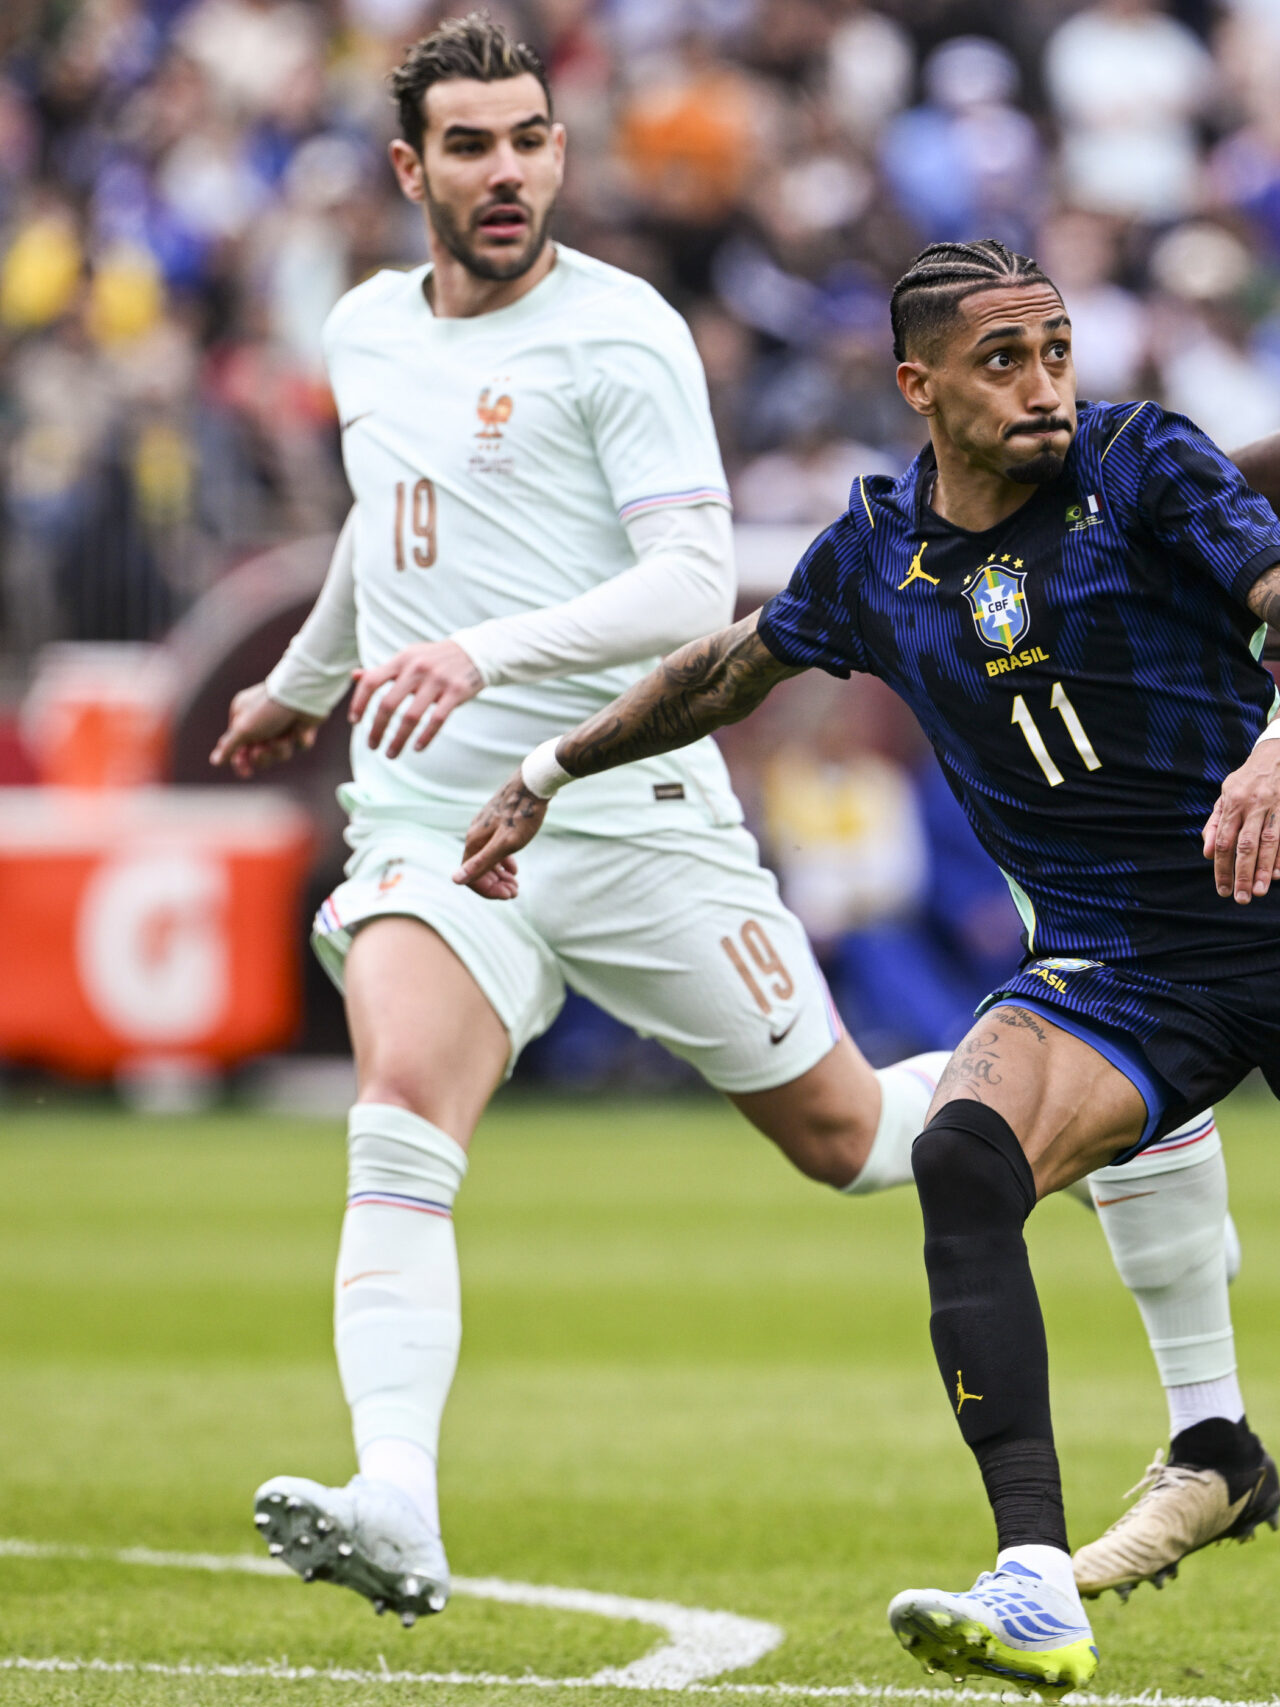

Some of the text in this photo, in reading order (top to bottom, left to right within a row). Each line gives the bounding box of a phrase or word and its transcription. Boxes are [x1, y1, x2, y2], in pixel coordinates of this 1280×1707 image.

[395, 478, 438, 572] 19
[988, 598, 1009, 613] CBF
[985, 646, 1050, 678] BRASIL
[1011, 681, 1102, 787] 11
[76, 855, 230, 1045] G
[720, 918, 795, 1015] 19
